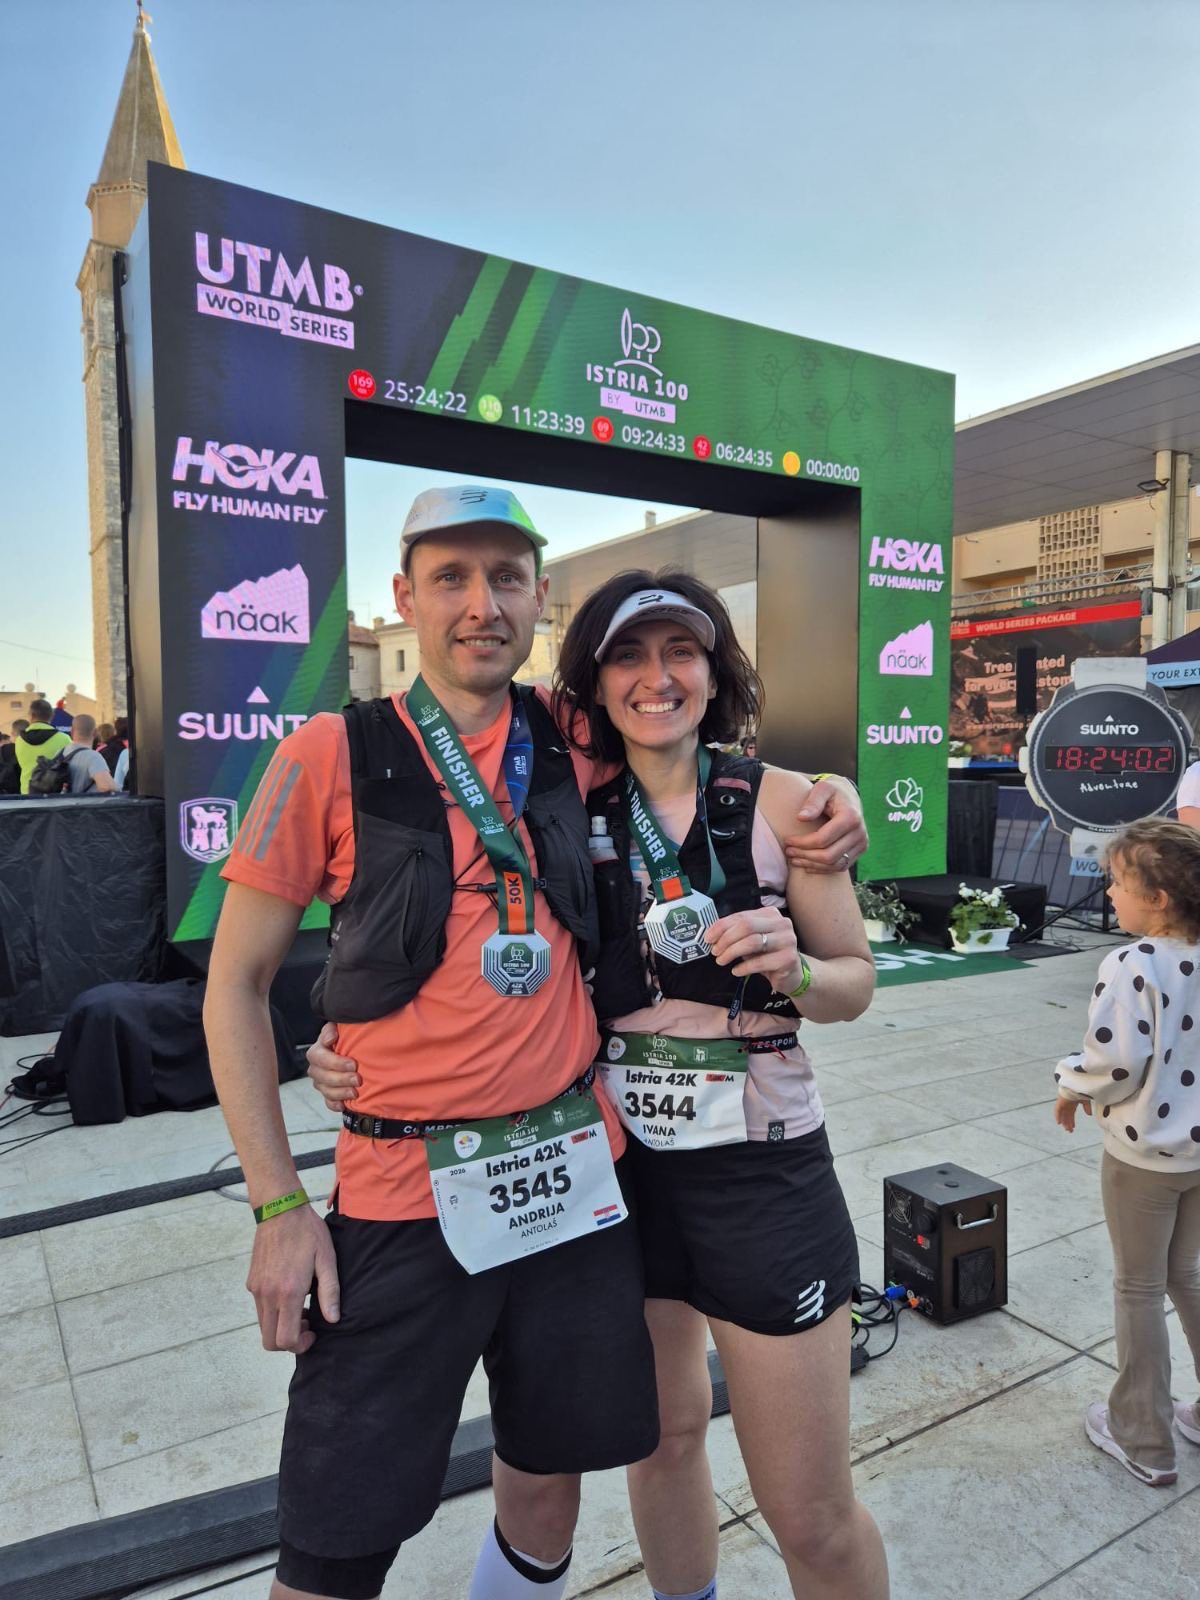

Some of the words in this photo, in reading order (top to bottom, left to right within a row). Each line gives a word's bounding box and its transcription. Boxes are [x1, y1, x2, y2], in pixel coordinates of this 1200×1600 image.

[195, 232, 354, 312] UTMB
[205, 291, 281, 322] WORLD
[290, 314, 349, 342] SERIES
[586, 363, 649, 393] ISTRIA
[655, 379, 689, 401] 100
[384, 380, 467, 413] 25:24:22
[607, 393, 621, 405] BY
[635, 402, 667, 418] UTMB
[511, 405, 585, 435] 11:23:39
[622, 426, 685, 452] 09:24:33
[172, 436, 326, 500] HOKA
[716, 443, 773, 468] 06:24:35
[806, 459, 860, 482] 00:00:00
[173, 490, 208, 510] FLY
[212, 494, 292, 520] HUMAN
[293, 505, 326, 525] FLY
[868, 536, 944, 575] HOKA
[868, 573, 887, 587] FLY
[887, 575, 927, 592] HUMAN
[927, 578, 944, 593] FLY
[216, 603, 299, 635] näak
[976, 621, 1005, 633] WORLD
[1005, 617, 1035, 629] SERIES
[1035, 611, 1077, 625] PACKAGE
[886, 649, 928, 670] näak
[984, 662, 1013, 674] Tree
[1151, 670, 1181, 681] YOUR
[178, 712, 308, 740] SUUNT
[866, 724, 943, 745] SUUNTO
[1080, 724, 1139, 736] SUUNTO
[431, 726, 486, 808] FINISHER
[1056, 747, 1174, 771] 18:24:02
[630, 792, 667, 863] FINISHER
[507, 878, 522, 905] 50K
[626, 1069, 662, 1085] Istria
[665, 1072, 698, 1087] 42K
[625, 1091, 696, 1121] 3544
[643, 1123, 676, 1137] IVANA
[450, 1168, 466, 1177] 2026
[486, 1155, 530, 1178] Istria
[534, 1140, 567, 1163] 42K
[489, 1165, 572, 1214] 3545
[508, 1202, 565, 1230] ANDRIJA
[521, 1217, 558, 1239] ANTOLAŠ
